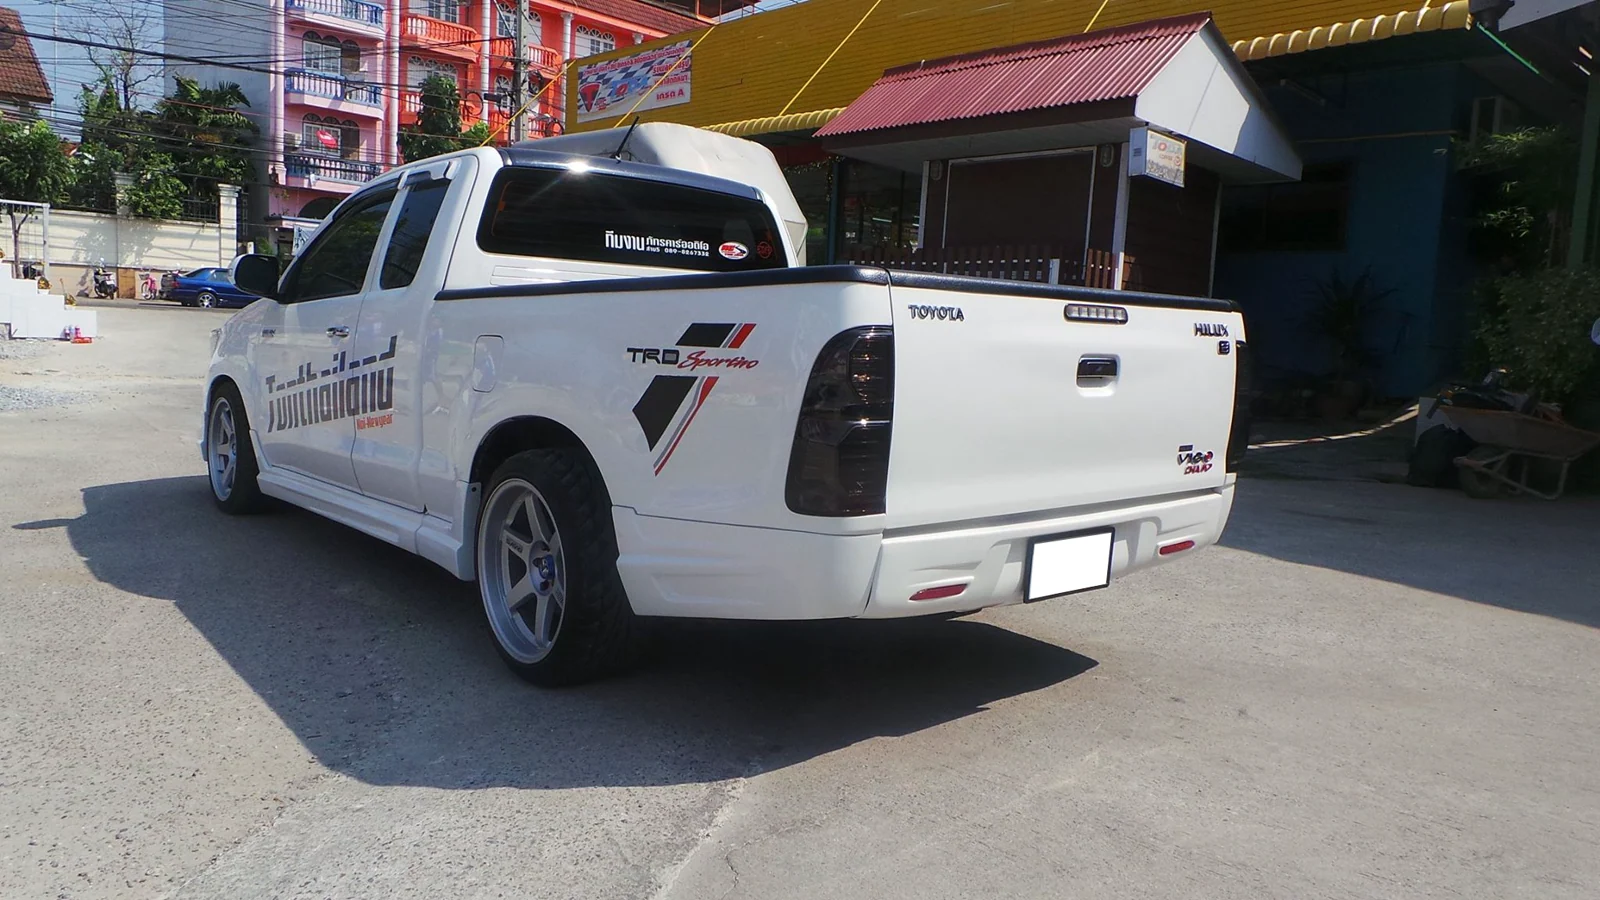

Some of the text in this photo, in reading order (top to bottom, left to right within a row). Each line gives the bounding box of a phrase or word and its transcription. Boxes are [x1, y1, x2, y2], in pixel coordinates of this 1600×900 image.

[677, 88, 685, 97] A
[605, 230, 645, 251] ทีมงาน
[908, 304, 965, 321] TOYOTA
[1194, 323, 1229, 337] HILUX
[627, 347, 759, 371] TRD Sportivo
[1177, 451, 1214, 466] VIGO
